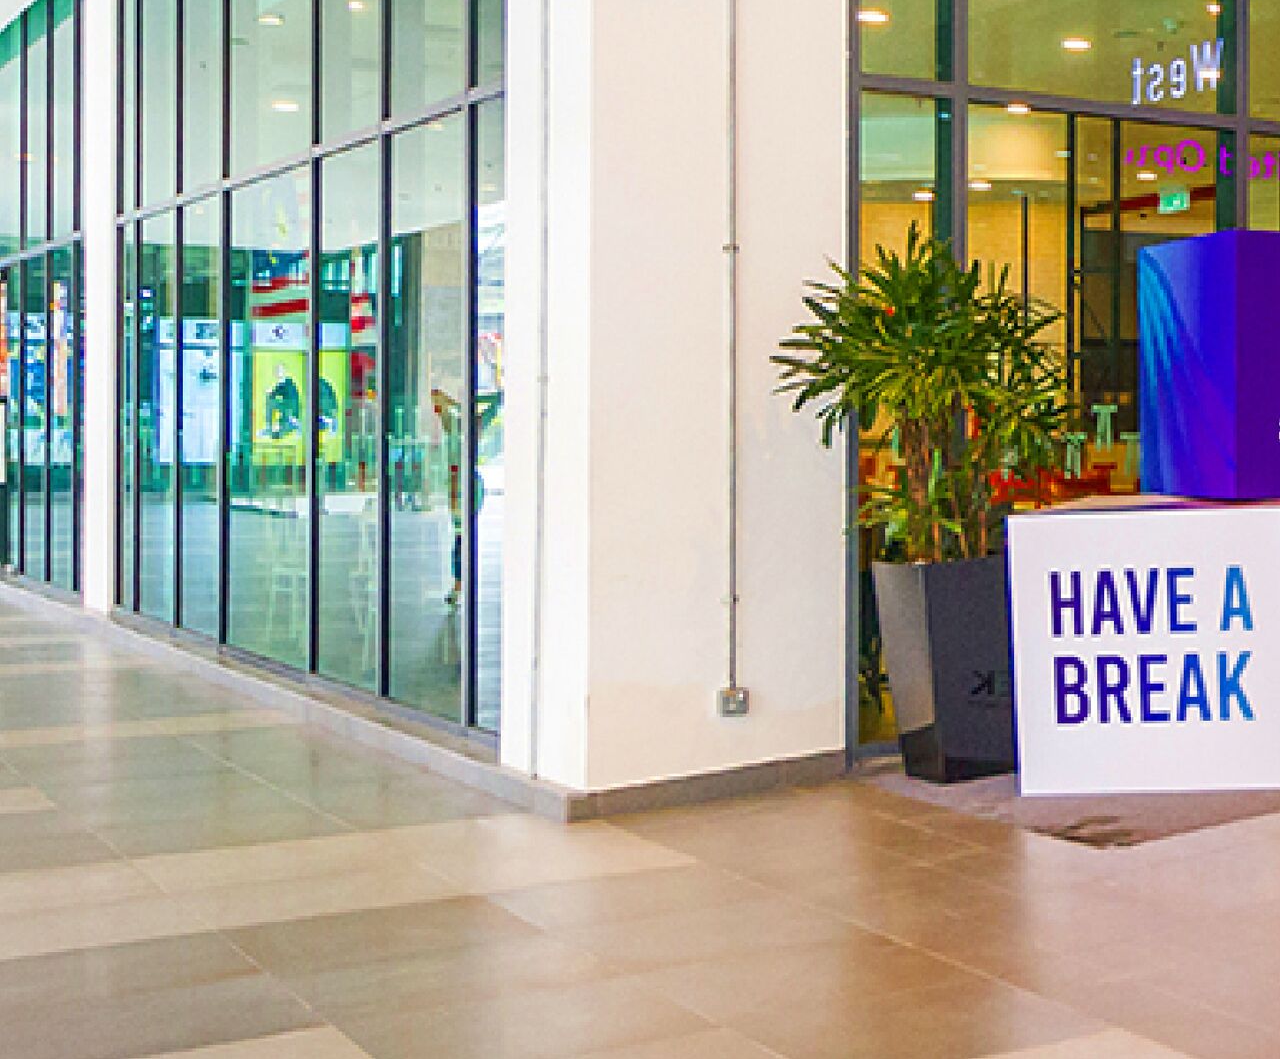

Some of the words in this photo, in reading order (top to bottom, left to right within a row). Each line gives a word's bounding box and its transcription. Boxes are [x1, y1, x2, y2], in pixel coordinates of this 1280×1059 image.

[1050, 567, 1198, 636] HAVE
[1219, 564, 1254, 632] A
[1053, 651, 1257, 724] BREAK
